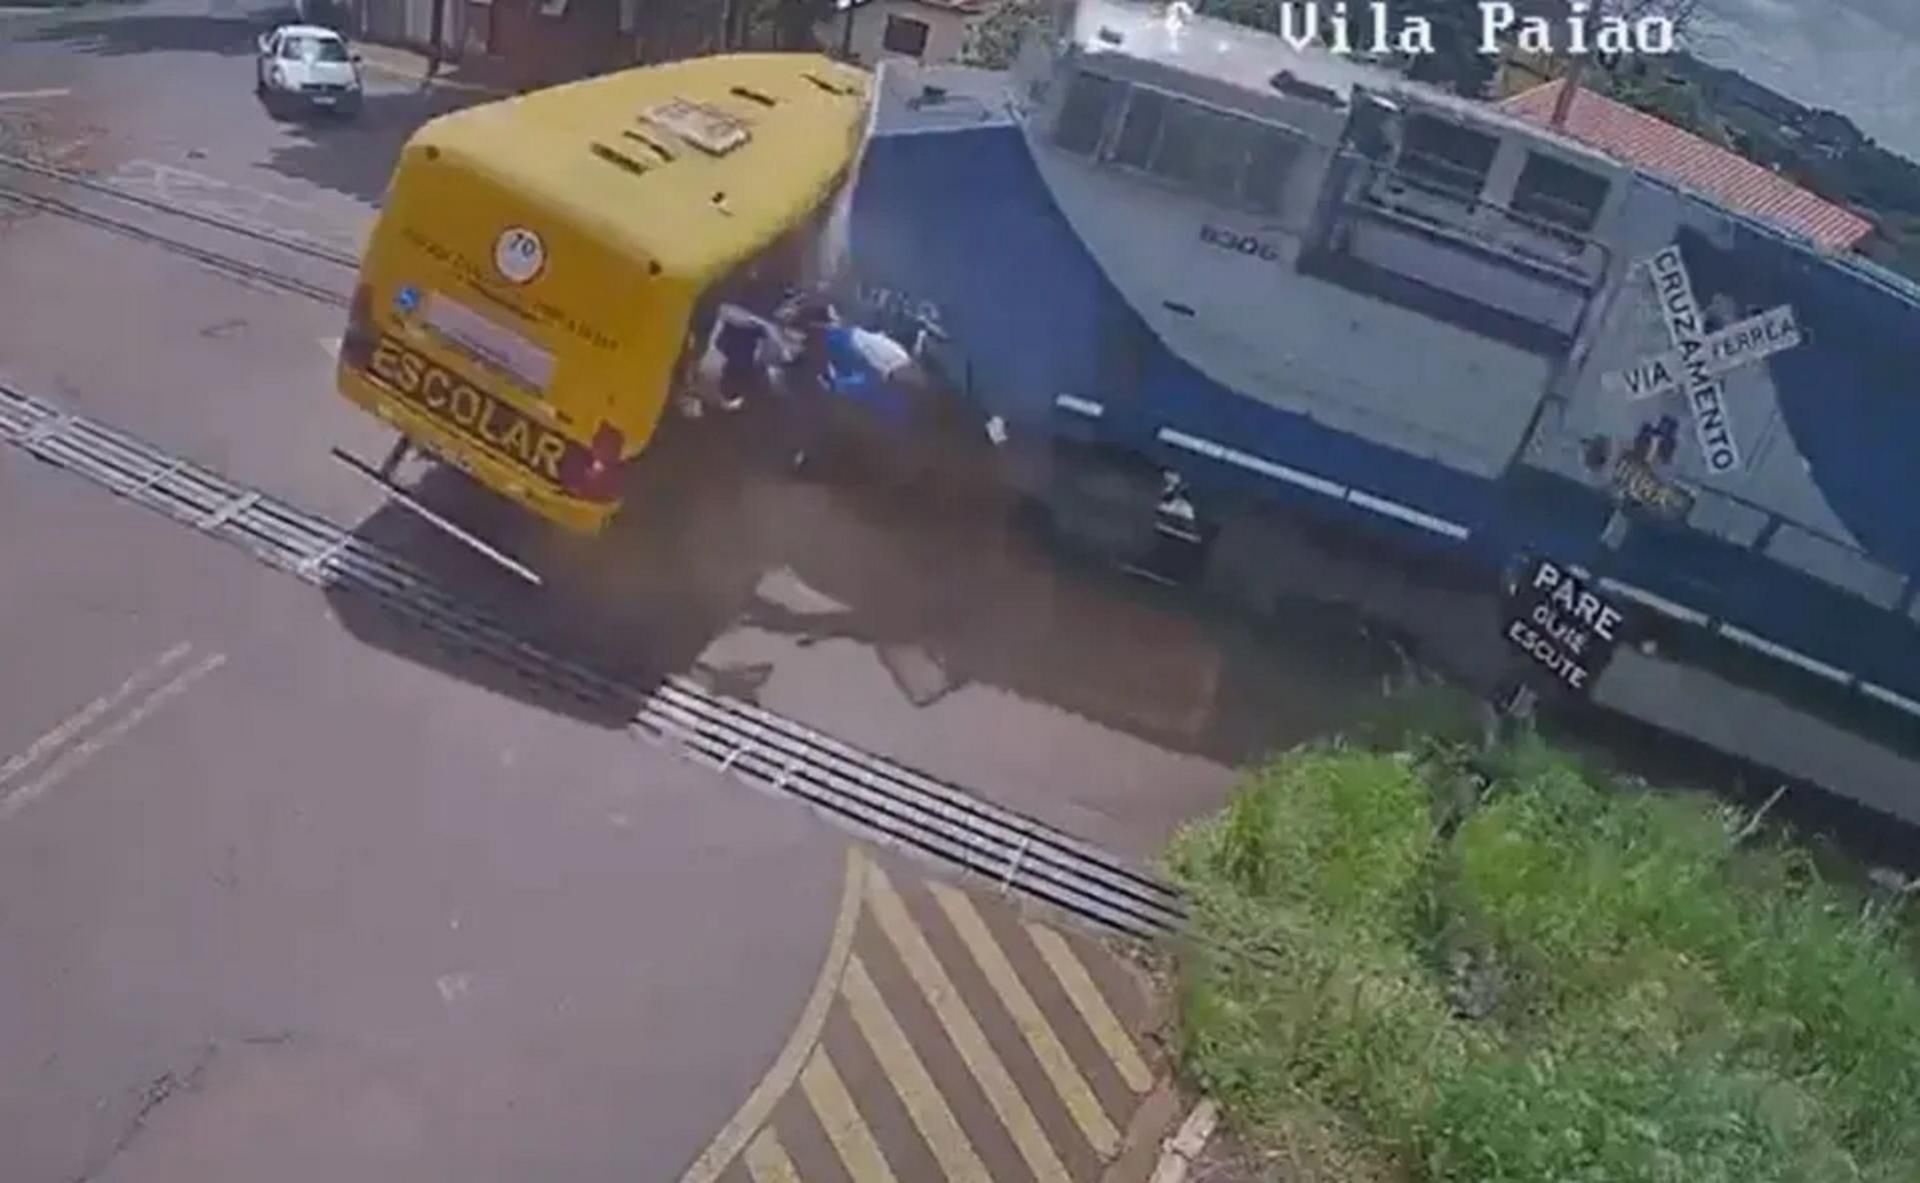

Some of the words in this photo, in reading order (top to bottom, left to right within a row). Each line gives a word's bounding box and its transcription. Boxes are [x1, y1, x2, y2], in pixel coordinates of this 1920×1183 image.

[509, 232, 536, 257] 70
[1624, 361, 1672, 394] VIA
[1654, 251, 1734, 470] CRUZAMENTO
[371, 335, 567, 478] ESCOLAR
[1532, 561, 1623, 641] PARE
[1509, 620, 1588, 689] ESCUTE
